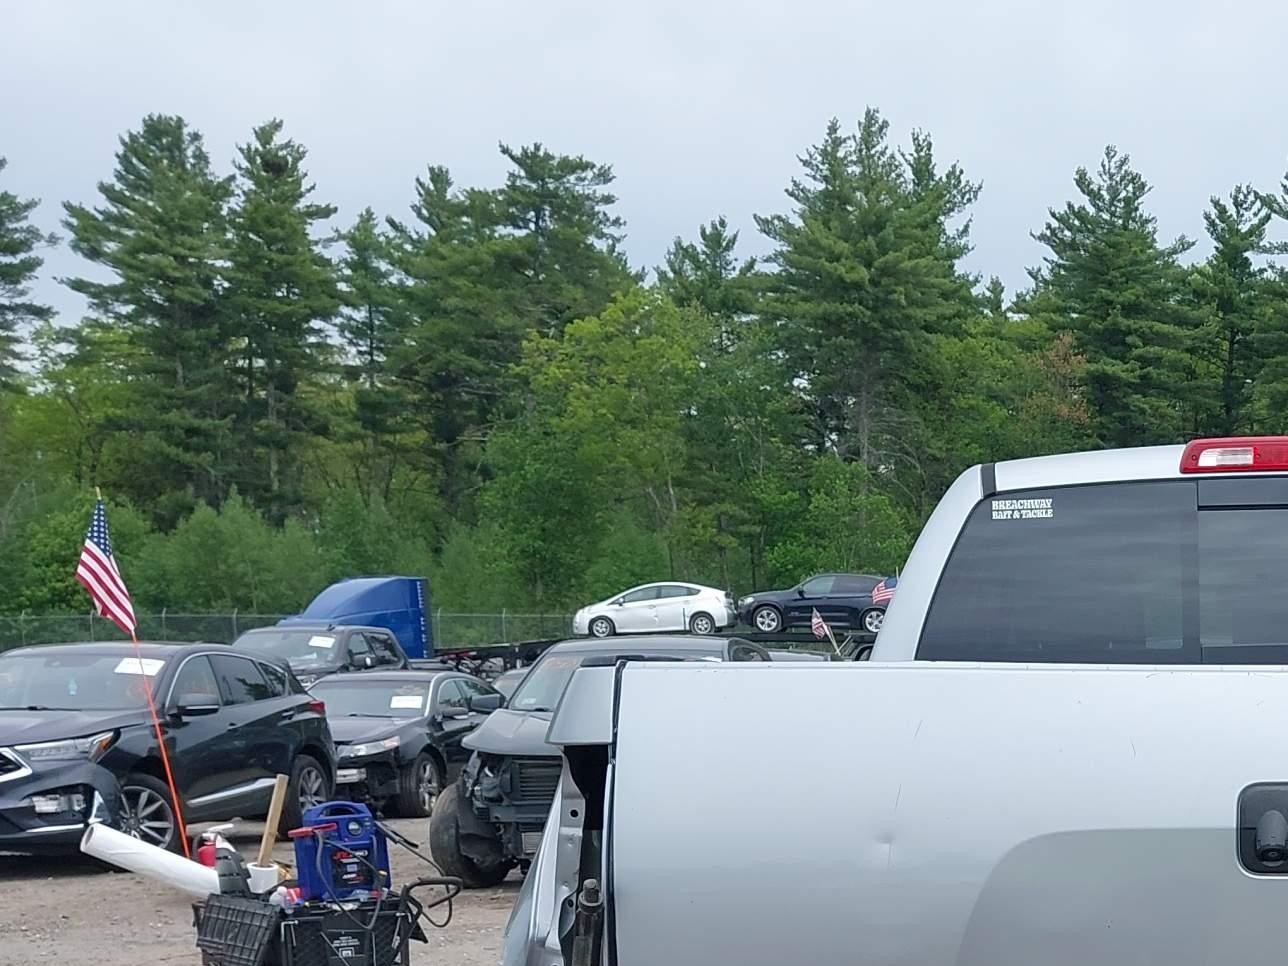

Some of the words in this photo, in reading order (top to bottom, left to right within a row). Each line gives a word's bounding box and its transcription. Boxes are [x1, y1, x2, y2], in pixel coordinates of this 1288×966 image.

[991, 499, 1053, 510] BREACHWAY
[991, 510, 1012, 520] BAIT
[1012, 510, 1020, 519] &
[1021, 509, 1053, 519] TACKLE
